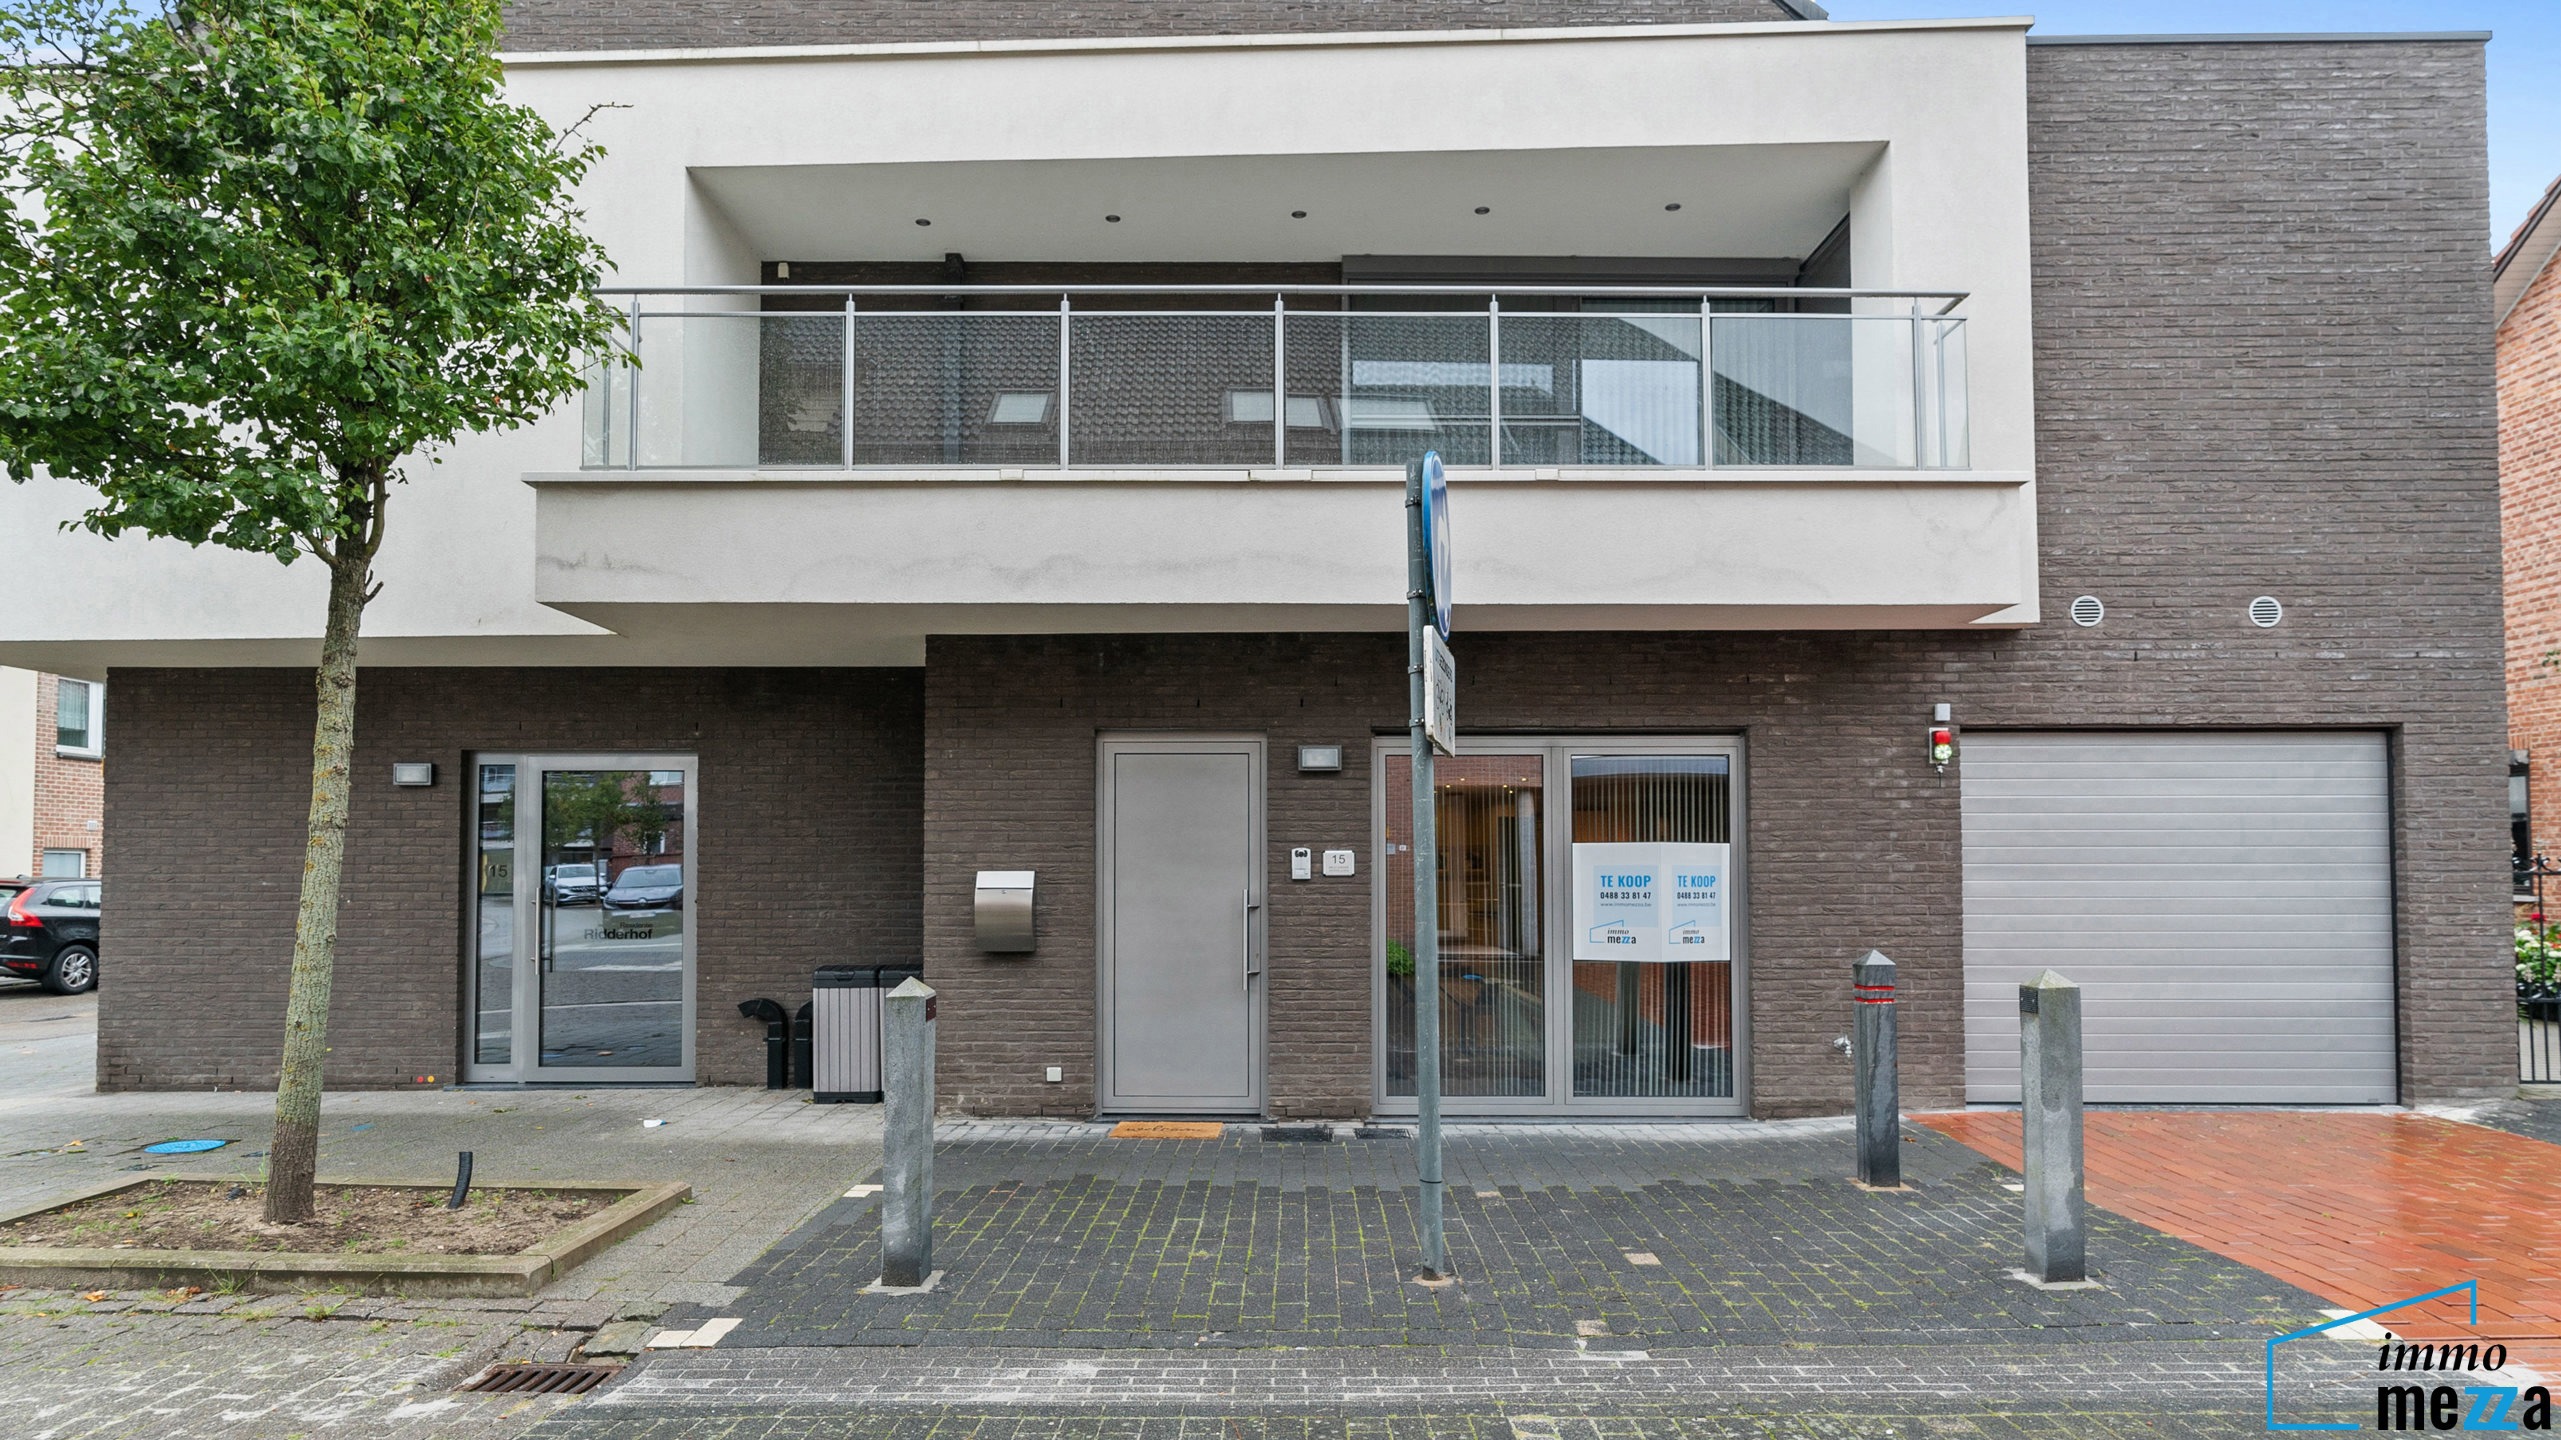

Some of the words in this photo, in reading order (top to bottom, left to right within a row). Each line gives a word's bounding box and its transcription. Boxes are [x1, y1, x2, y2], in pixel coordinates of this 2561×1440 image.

[1332, 854, 1346, 864] 15
[490, 864, 508, 878] 15
[1600, 875, 1614, 888] TE
[1618, 875, 1652, 888] KOOP
[1677, 875, 1688, 888] TE
[1691, 875, 1716, 888] KOOP
[584, 928, 653, 940] Ridderhof
[1607, 936, 1637, 944] mezza
[1682, 936, 1705, 944] mezza
